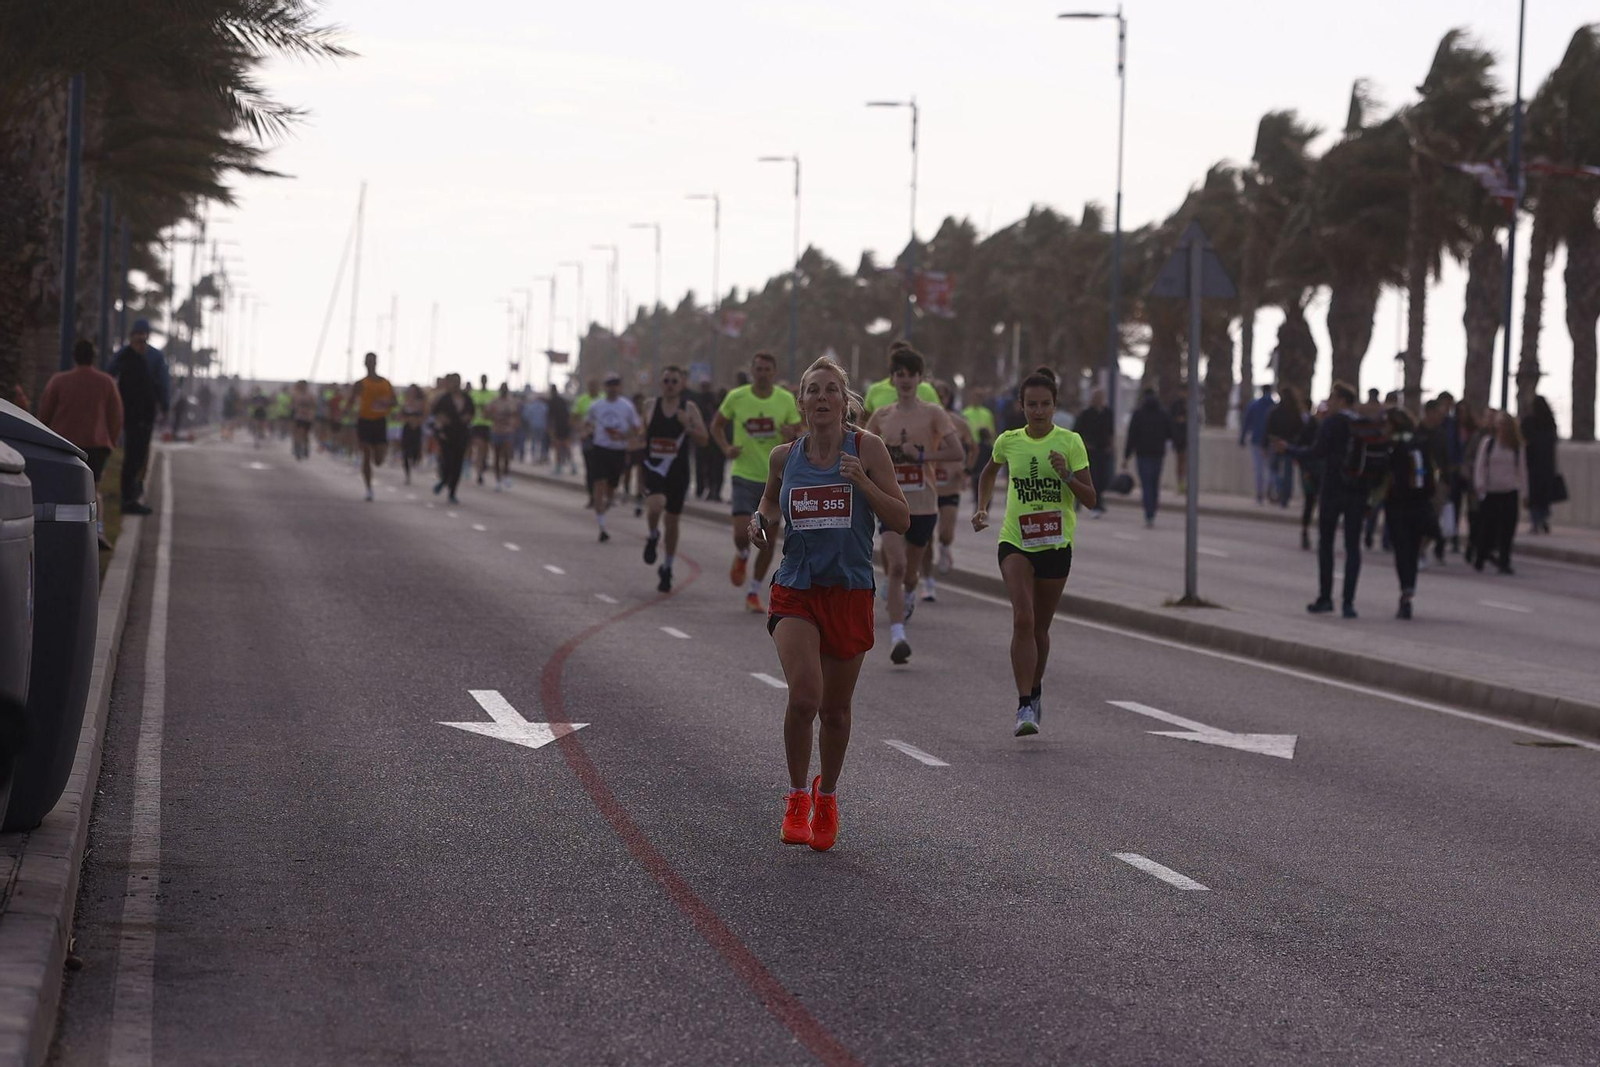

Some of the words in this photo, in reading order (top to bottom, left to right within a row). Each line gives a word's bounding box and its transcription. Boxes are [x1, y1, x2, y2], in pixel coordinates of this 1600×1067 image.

[1012, 477, 1062, 490] BRUNCH
[1017, 489, 1042, 504] RUN
[822, 499, 845, 510] 355
[1043, 522, 1059, 531] 363
